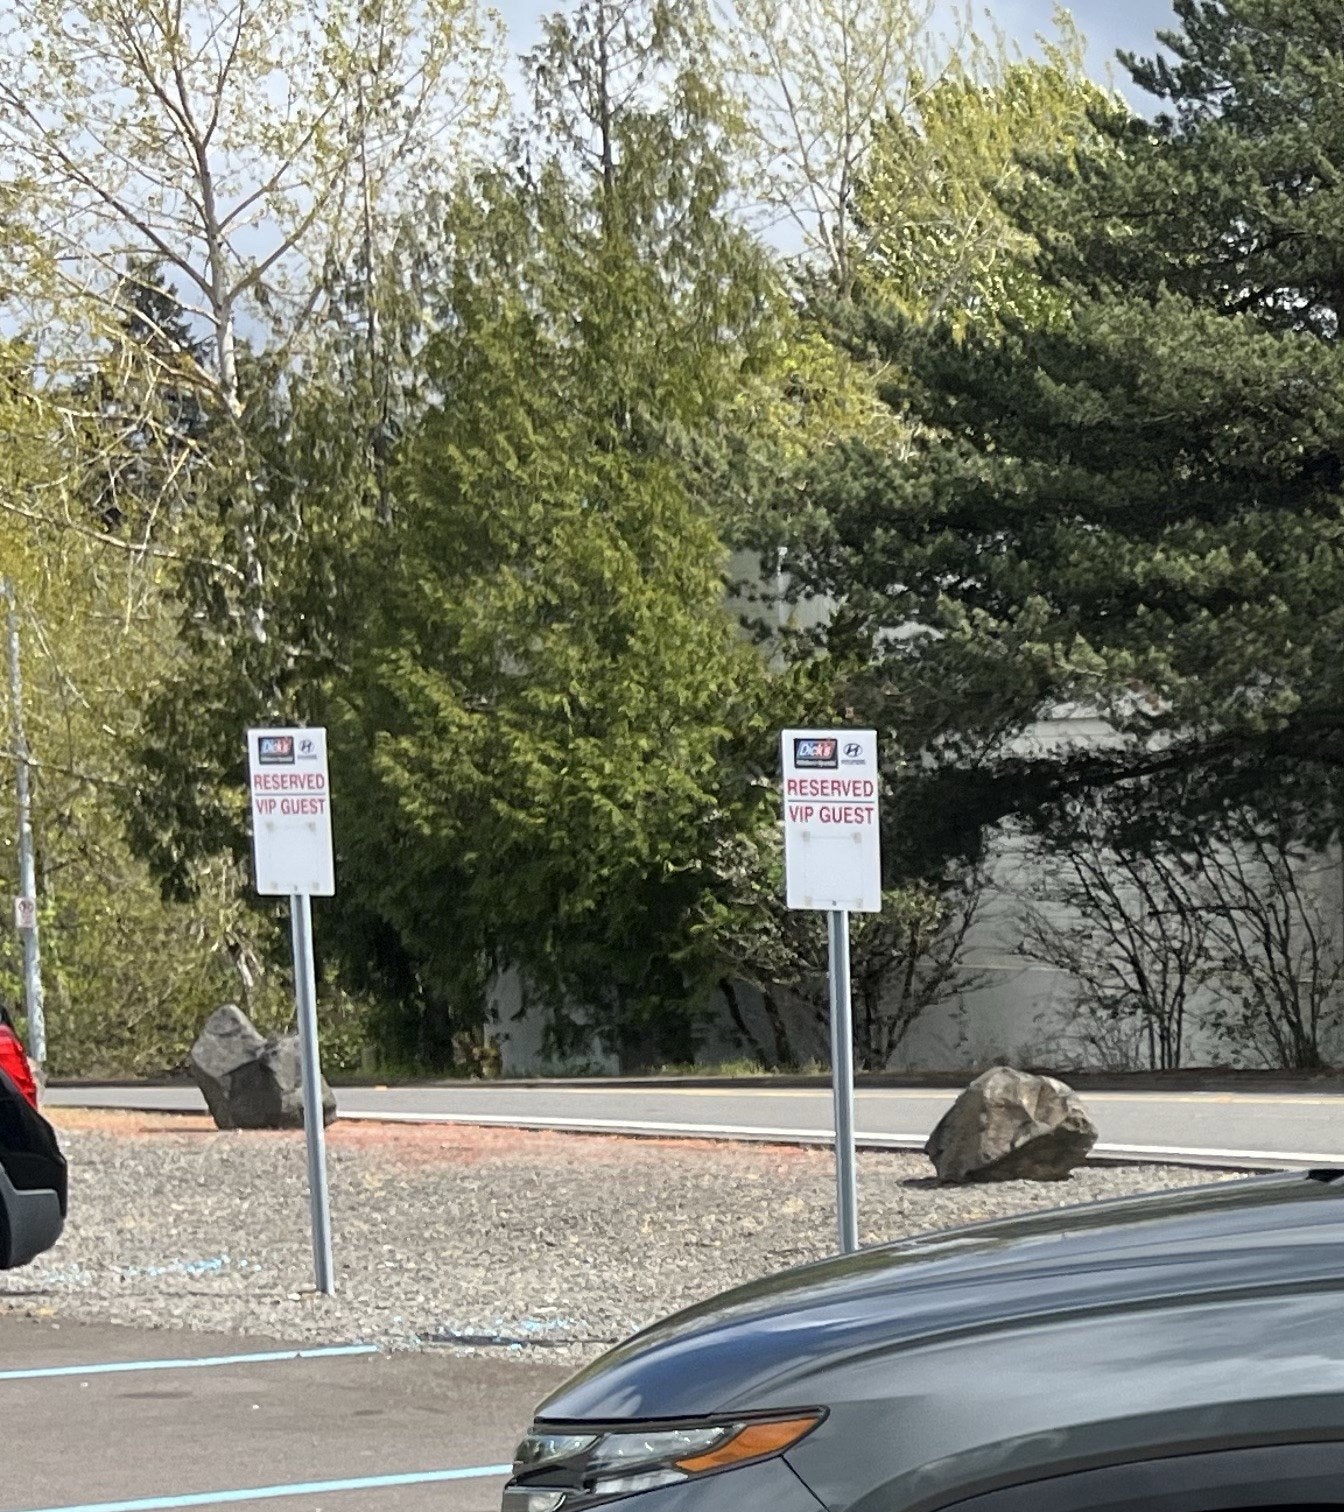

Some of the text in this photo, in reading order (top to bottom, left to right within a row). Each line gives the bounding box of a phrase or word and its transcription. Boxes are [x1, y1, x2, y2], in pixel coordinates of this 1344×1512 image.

[253, 773, 325, 790] RESERVED
[788, 779, 874, 797] RESERVED
[255, 798, 326, 815] VIP GUEST
[789, 806, 874, 824] VIP GUEST
